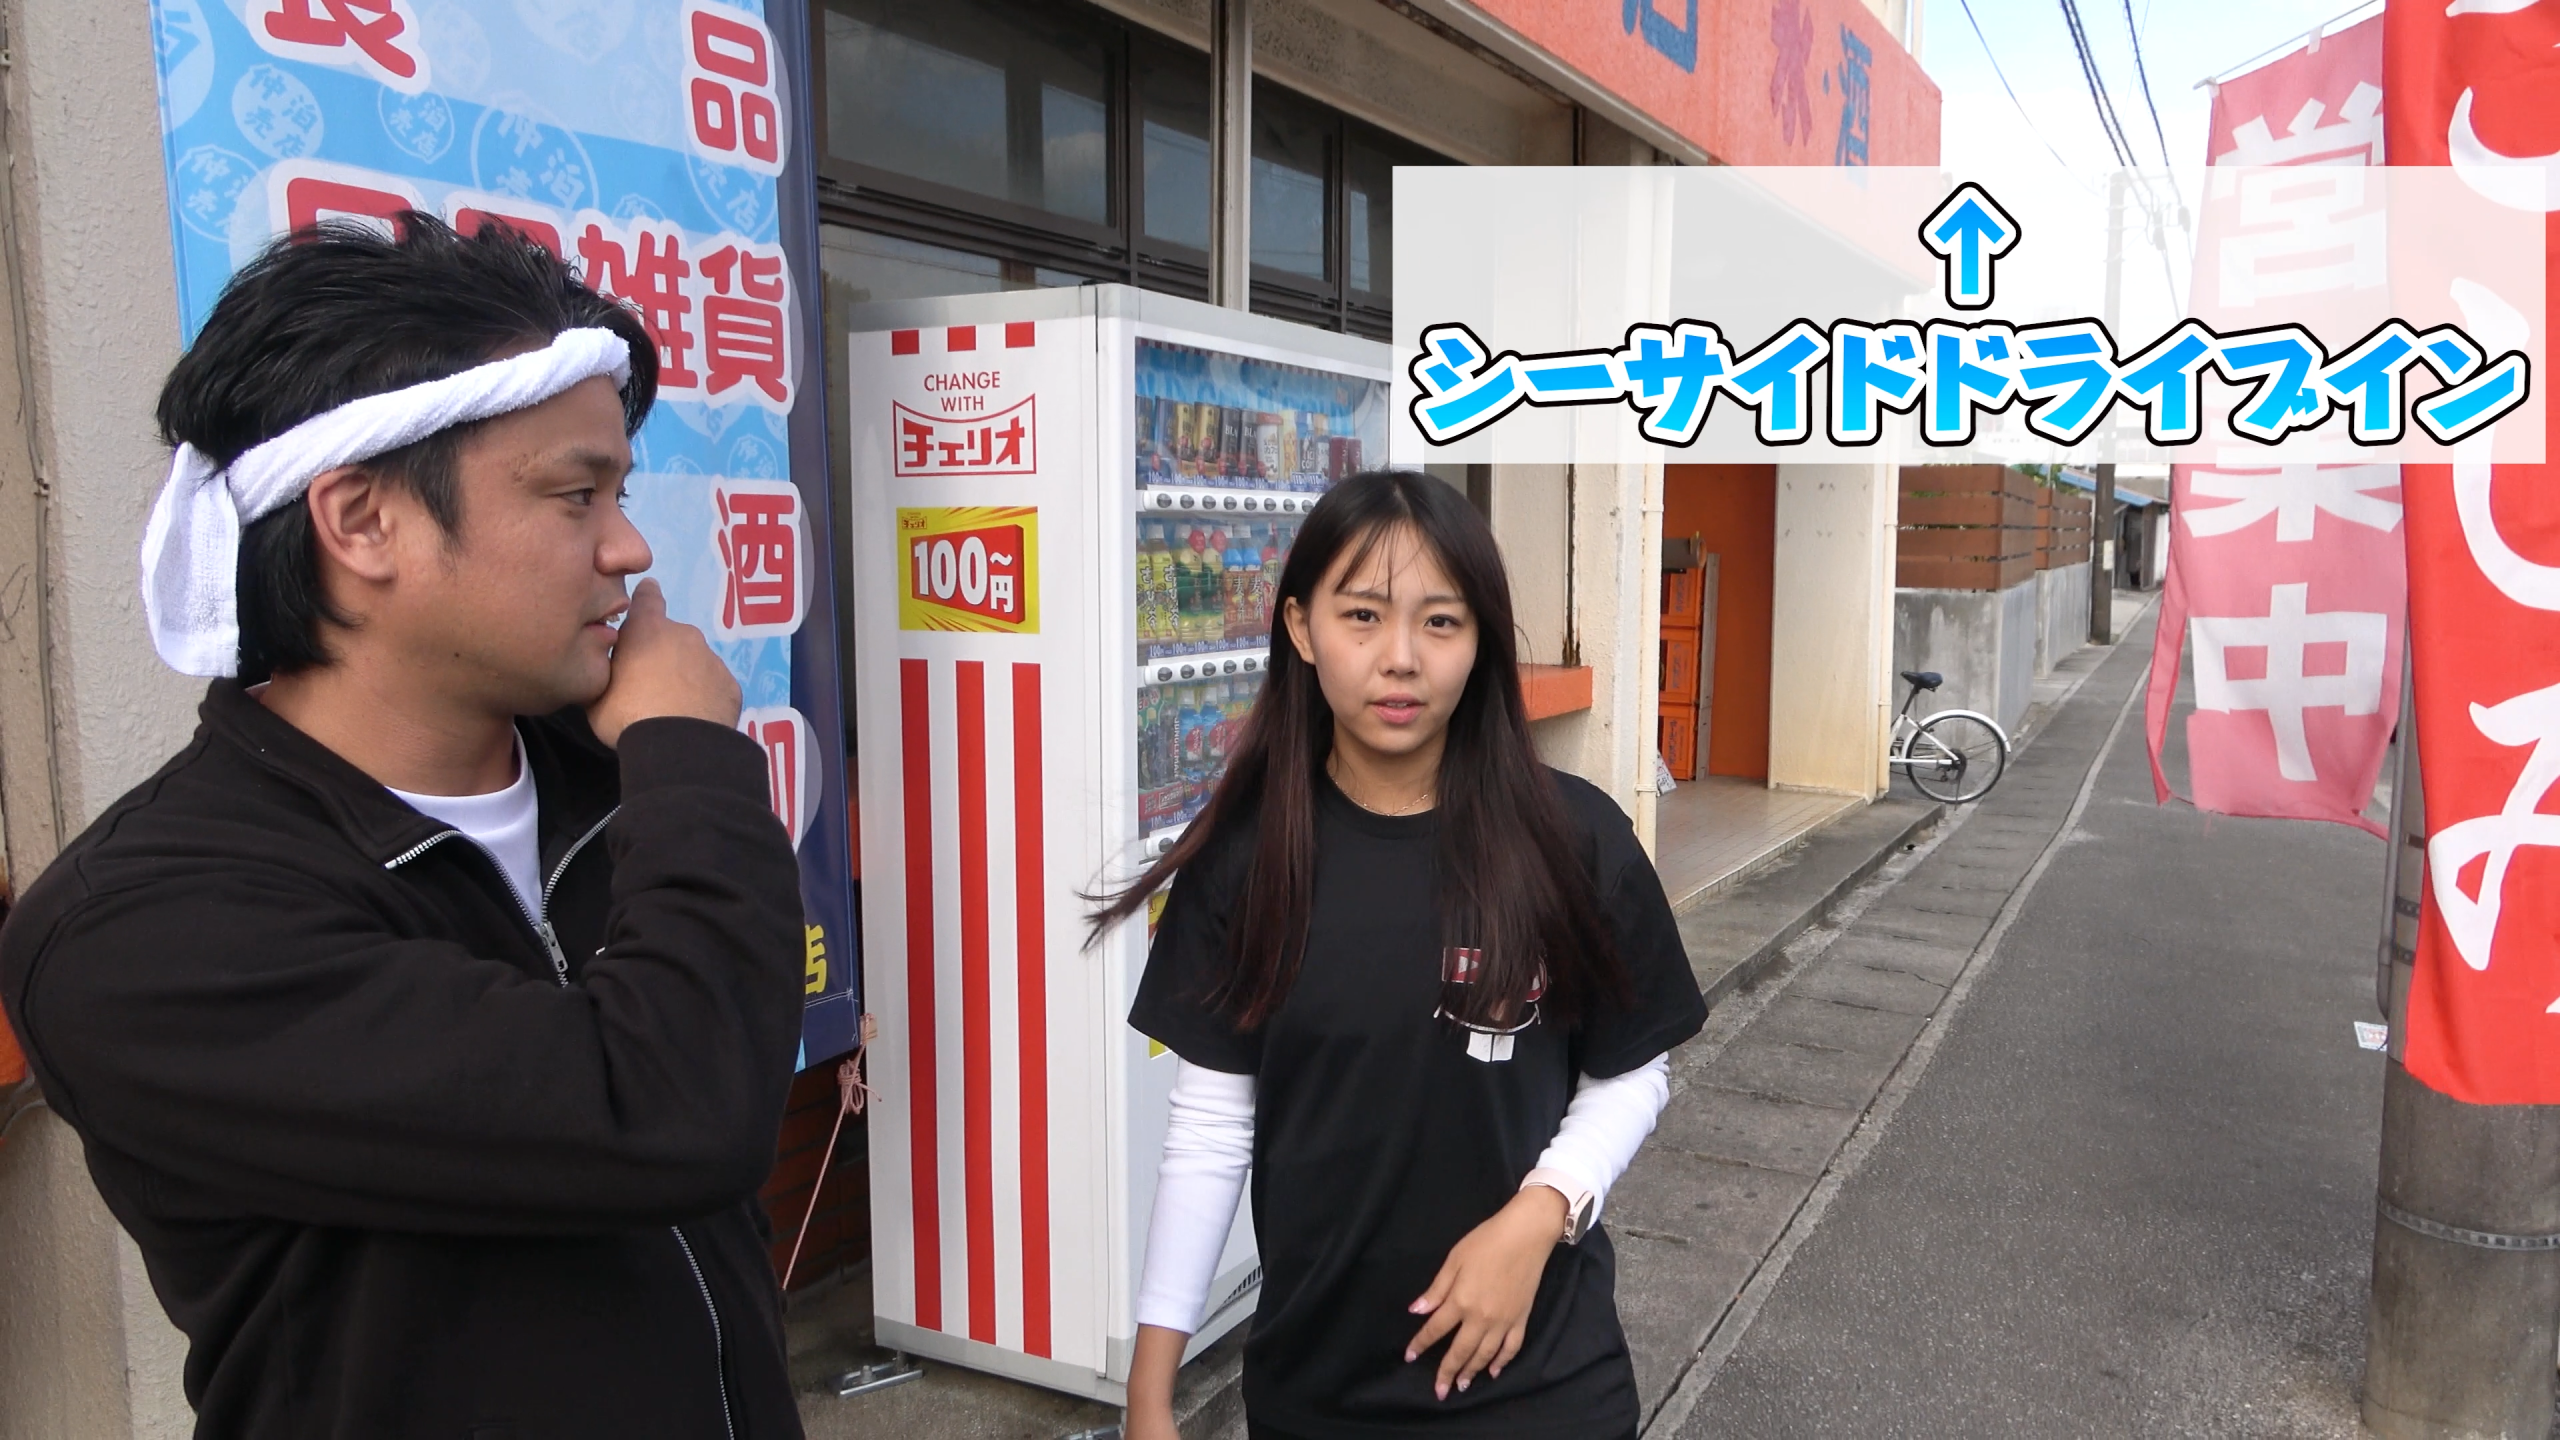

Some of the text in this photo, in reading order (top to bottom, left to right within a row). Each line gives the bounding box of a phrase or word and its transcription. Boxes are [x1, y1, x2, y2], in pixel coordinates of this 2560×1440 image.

[691, 10, 778, 164] 品
[286, 177, 790, 403] 雑貨
[924, 371, 1001, 392] CHANGE
[940, 395, 984, 413] WITH
[902, 415, 1026, 468] チェリオ
[716, 487, 795, 630] 酒
